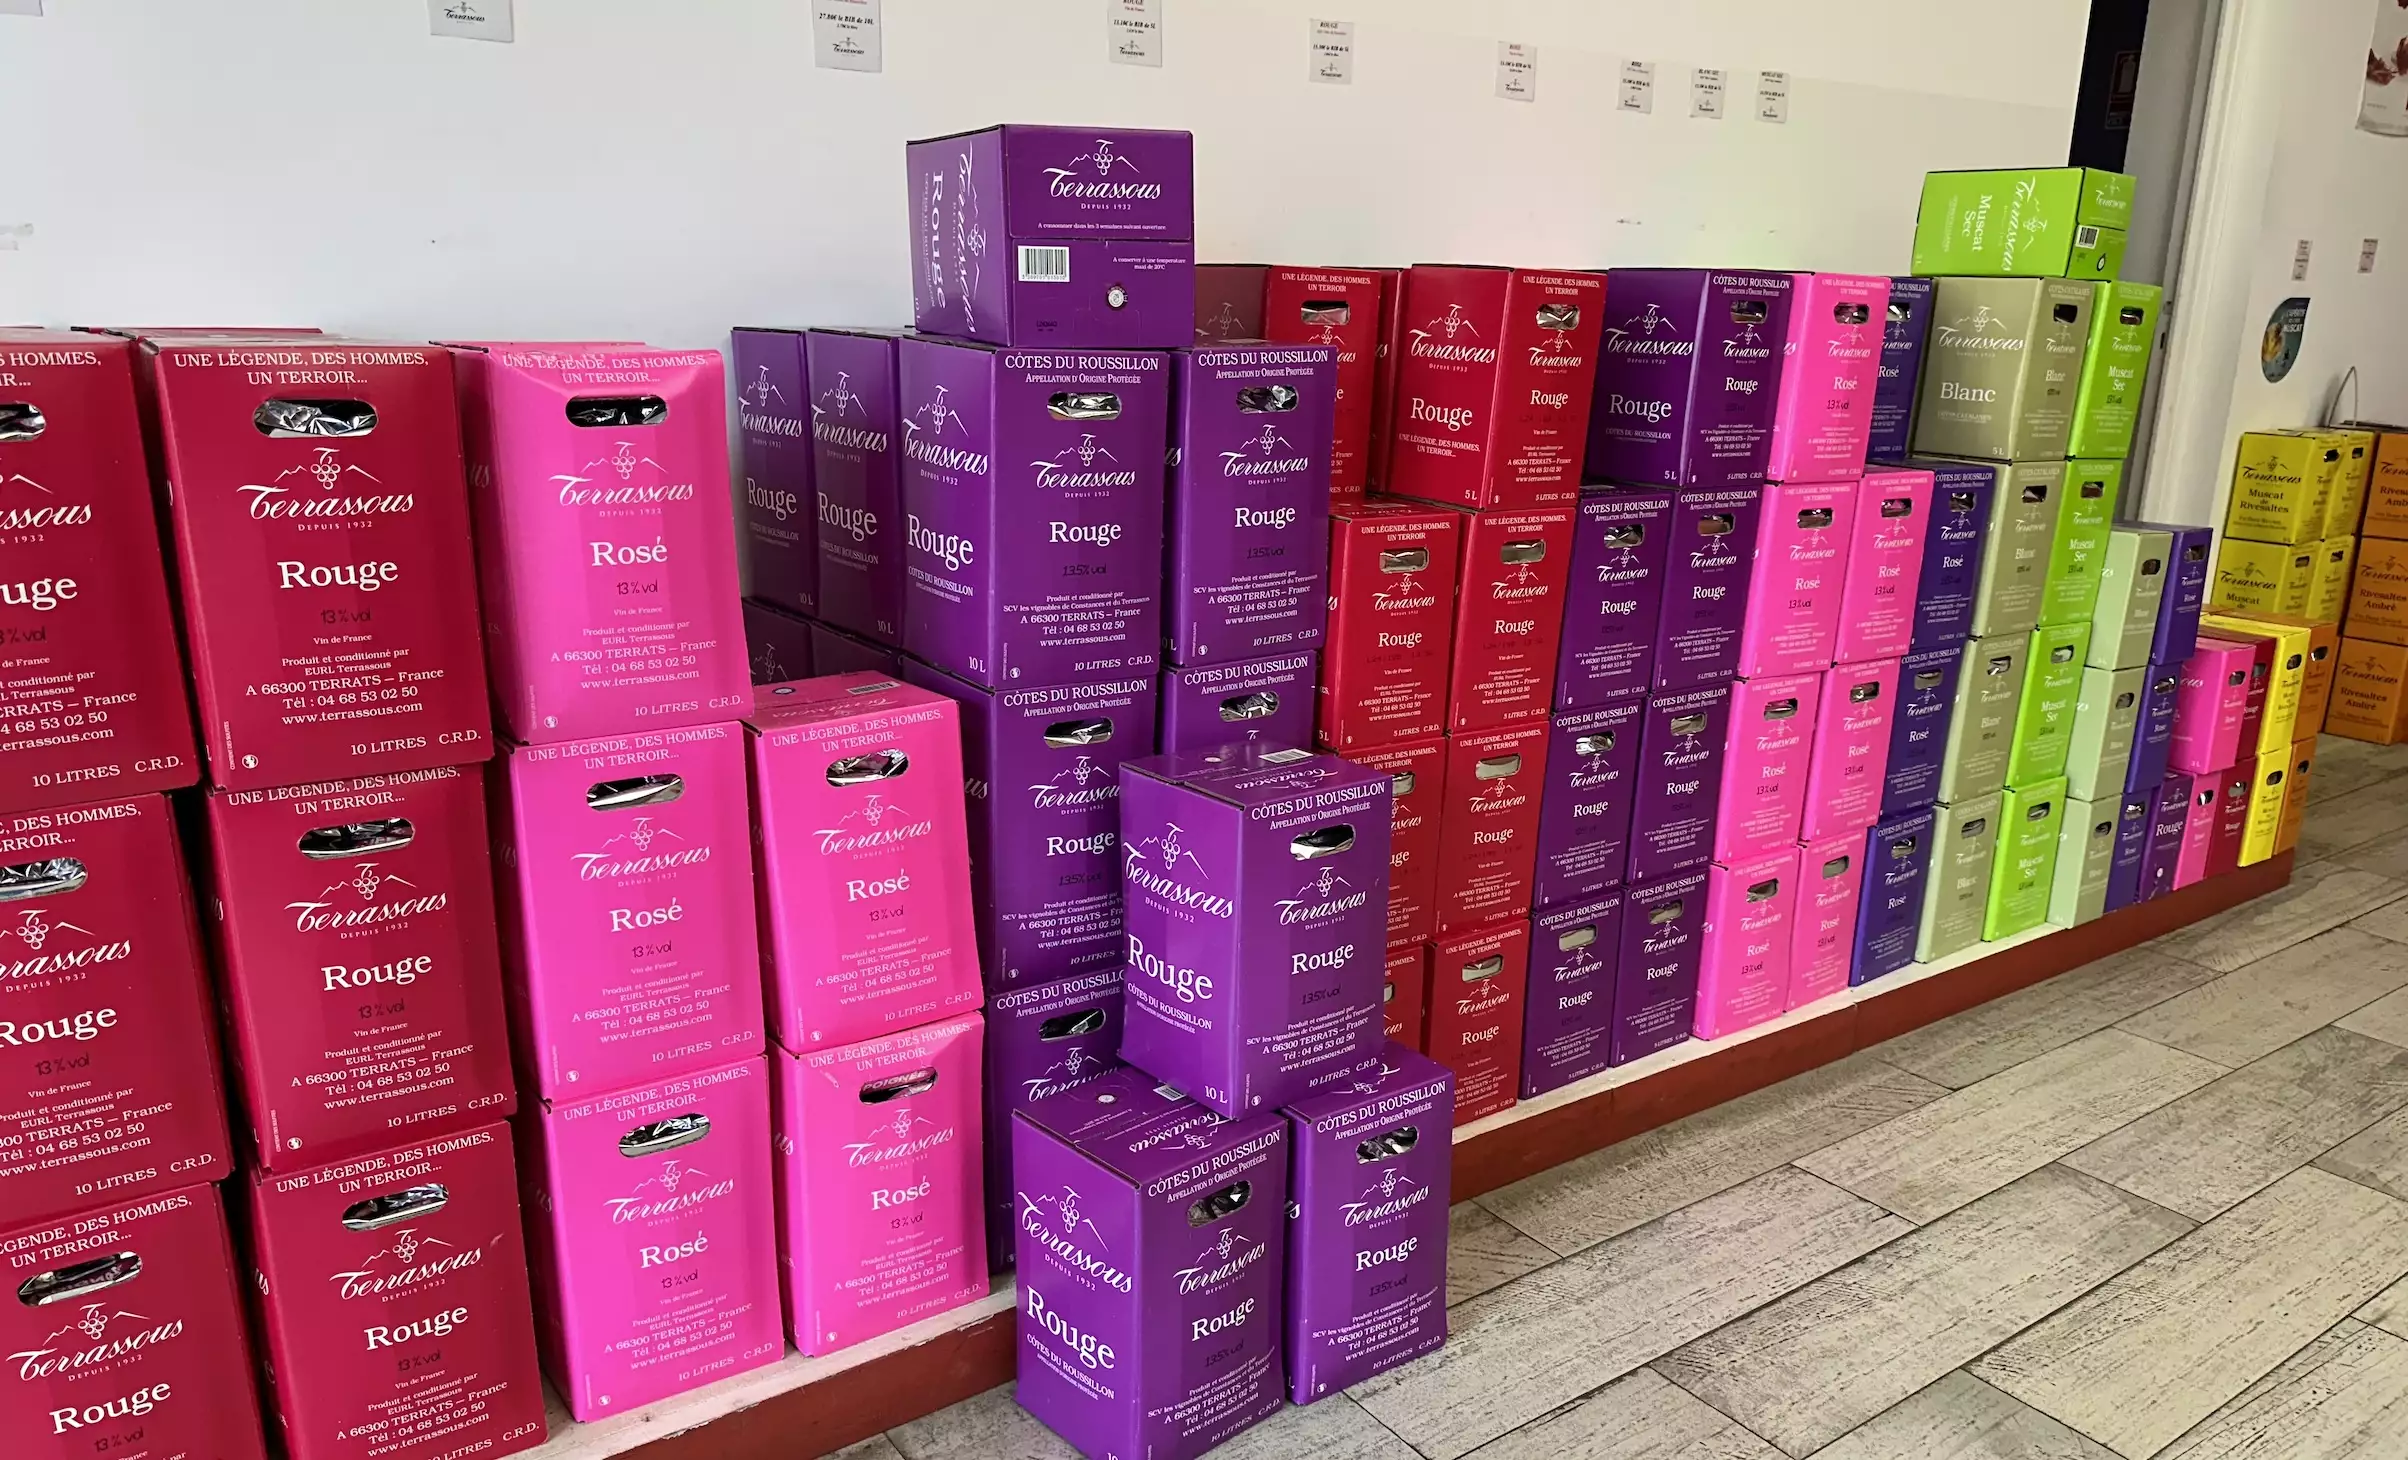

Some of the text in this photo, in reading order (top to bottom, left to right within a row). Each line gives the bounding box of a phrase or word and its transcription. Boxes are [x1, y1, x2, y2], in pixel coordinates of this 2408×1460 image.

[1043, 167, 1160, 199] Terrassous
[1961, 210, 1976, 237] Sec
[1972, 194, 1993, 252] Muscat
[2002, 175, 2036, 273] Terrassous
[931, 170, 946, 309] Rouge
[958, 140, 977, 333] Terrassous
[1713, 274, 1790, 289] CÔTES DU ROUSSILLON
[1409, 328, 1496, 363] Terrassous
[1606, 327, 1693, 356] Terrassous
[1939, 325, 2024, 351] Terrassous
[9, 351, 101, 366] HOMMES,
[174, 349, 428, 367] UNE LÉGENDE, DES HOMMES,
[1005, 352, 1159, 370] CÔTES DU ROUSSILLON
[247, 372, 272, 385] UN
[1878, 365, 1899, 377] Rosé
[2108, 365, 2134, 378] Muscat
[1725, 377, 1758, 395] Rouge
[1833, 376, 1857, 390] Rosé
[1941, 382, 1996, 402] Blanc
[2112, 378, 2126, 391] Sec
[1530, 390, 1568, 409] Rouge
[1610, 395, 1672, 423] Rouge
[738, 396, 802, 438] Terrassous
[1411, 398, 1473, 431] Rouge
[811, 403, 887, 452] Terrassous
[902, 417, 988, 477] Terrassous
[1030, 461, 1135, 488] Terrassous
[1664, 470, 1677, 480] 5 L
[549, 474, 693, 506] Terrassous
[2248, 488, 2284, 500] Muscat
[237, 485, 413, 519] Terrassous
[2240, 498, 2289, 513] Rivesaltes
[2260, 497, 2268, 505] de
[347, 521, 372, 529] 1932
[818, 491, 877, 542] Rouge
[908, 514, 973, 571] Rouge
[1049, 522, 1121, 547] Rouge
[1387, 532, 1426, 541] UN TERROIR
[590, 536, 667, 566] Rosé
[2069, 539, 2095, 550] Muscat
[1943, 555, 1963, 568] Rosé
[2074, 551, 2087, 562] Sec
[277, 561, 398, 591] Rouge
[1597, 565, 1648, 582] Terrassous
[1878, 564, 1900, 578] Rosé
[1491, 582, 1548, 599] Terrassous
[2226, 592, 2260, 605] Muscat
[2359, 588, 2407, 601] Rivesaltes
[1003, 604, 1018, 612] SCV
[1030, 604, 1061, 612] vignobles
[1062, 602, 1070, 610] de
[1112, 598, 1121, 606] du
[1121, 597, 1150, 605] Terrassous
[1372, 593, 1435, 611] Terrassous
[1601, 600, 1637, 615] Rouge
[2364, 600, 2396, 611] Ambré
[1494, 620, 1534, 635] Rouge
[313, 633, 373, 645] Vin de France
[1378, 632, 1422, 648] Rouge
[282, 649, 409, 666] Produit et conditionné par
[969, 656, 986, 673] 10 L
[305, 662, 392, 676] EURL Terrassous
[246, 670, 444, 696] A 66300 TERRATS France
[317, 695, 335, 706] 04
[339, 693, 356, 704] 68
[361, 691, 377, 702] 53
[381, 688, 398, 700] 02
[402, 686, 418, 697] 50
[2340, 686, 2388, 702] Rivesaltes
[281, 702, 423, 724] www.terrassous.com
[2345, 698, 2377, 711] Ambré
[351, 730, 481, 755] 10 LITRES C.R.D.
[1909, 731, 1929, 742] Rosé
[1762, 762, 1786, 778] Rosé
[1573, 801, 1608, 817] Rouge
[1473, 829, 1513, 845] Rouge
[2156, 821, 2183, 836] Rouge
[571, 847, 710, 881] Terrassous
[846, 869, 909, 902] Rosé
[1123, 839, 1233, 923] Terrassous
[284, 890, 446, 936] Terrassous
[609, 897, 682, 932] Rosé
[1128, 934, 1213, 1003] Rouge
[1292, 944, 1354, 975] Rouge
[321, 956, 432, 991] Rouge
[871, 1176, 930, 1210] Rosé
[1018, 1186, 1132, 1293] Terrassous
[640, 1231, 708, 1268] Rosé
[1356, 1237, 1417, 1271] Rouge
[1027, 1280, 1115, 1379] Rouge
[6, 1315, 182, 1381] Terrassous
[49, 1383, 171, 1434] Rouge
